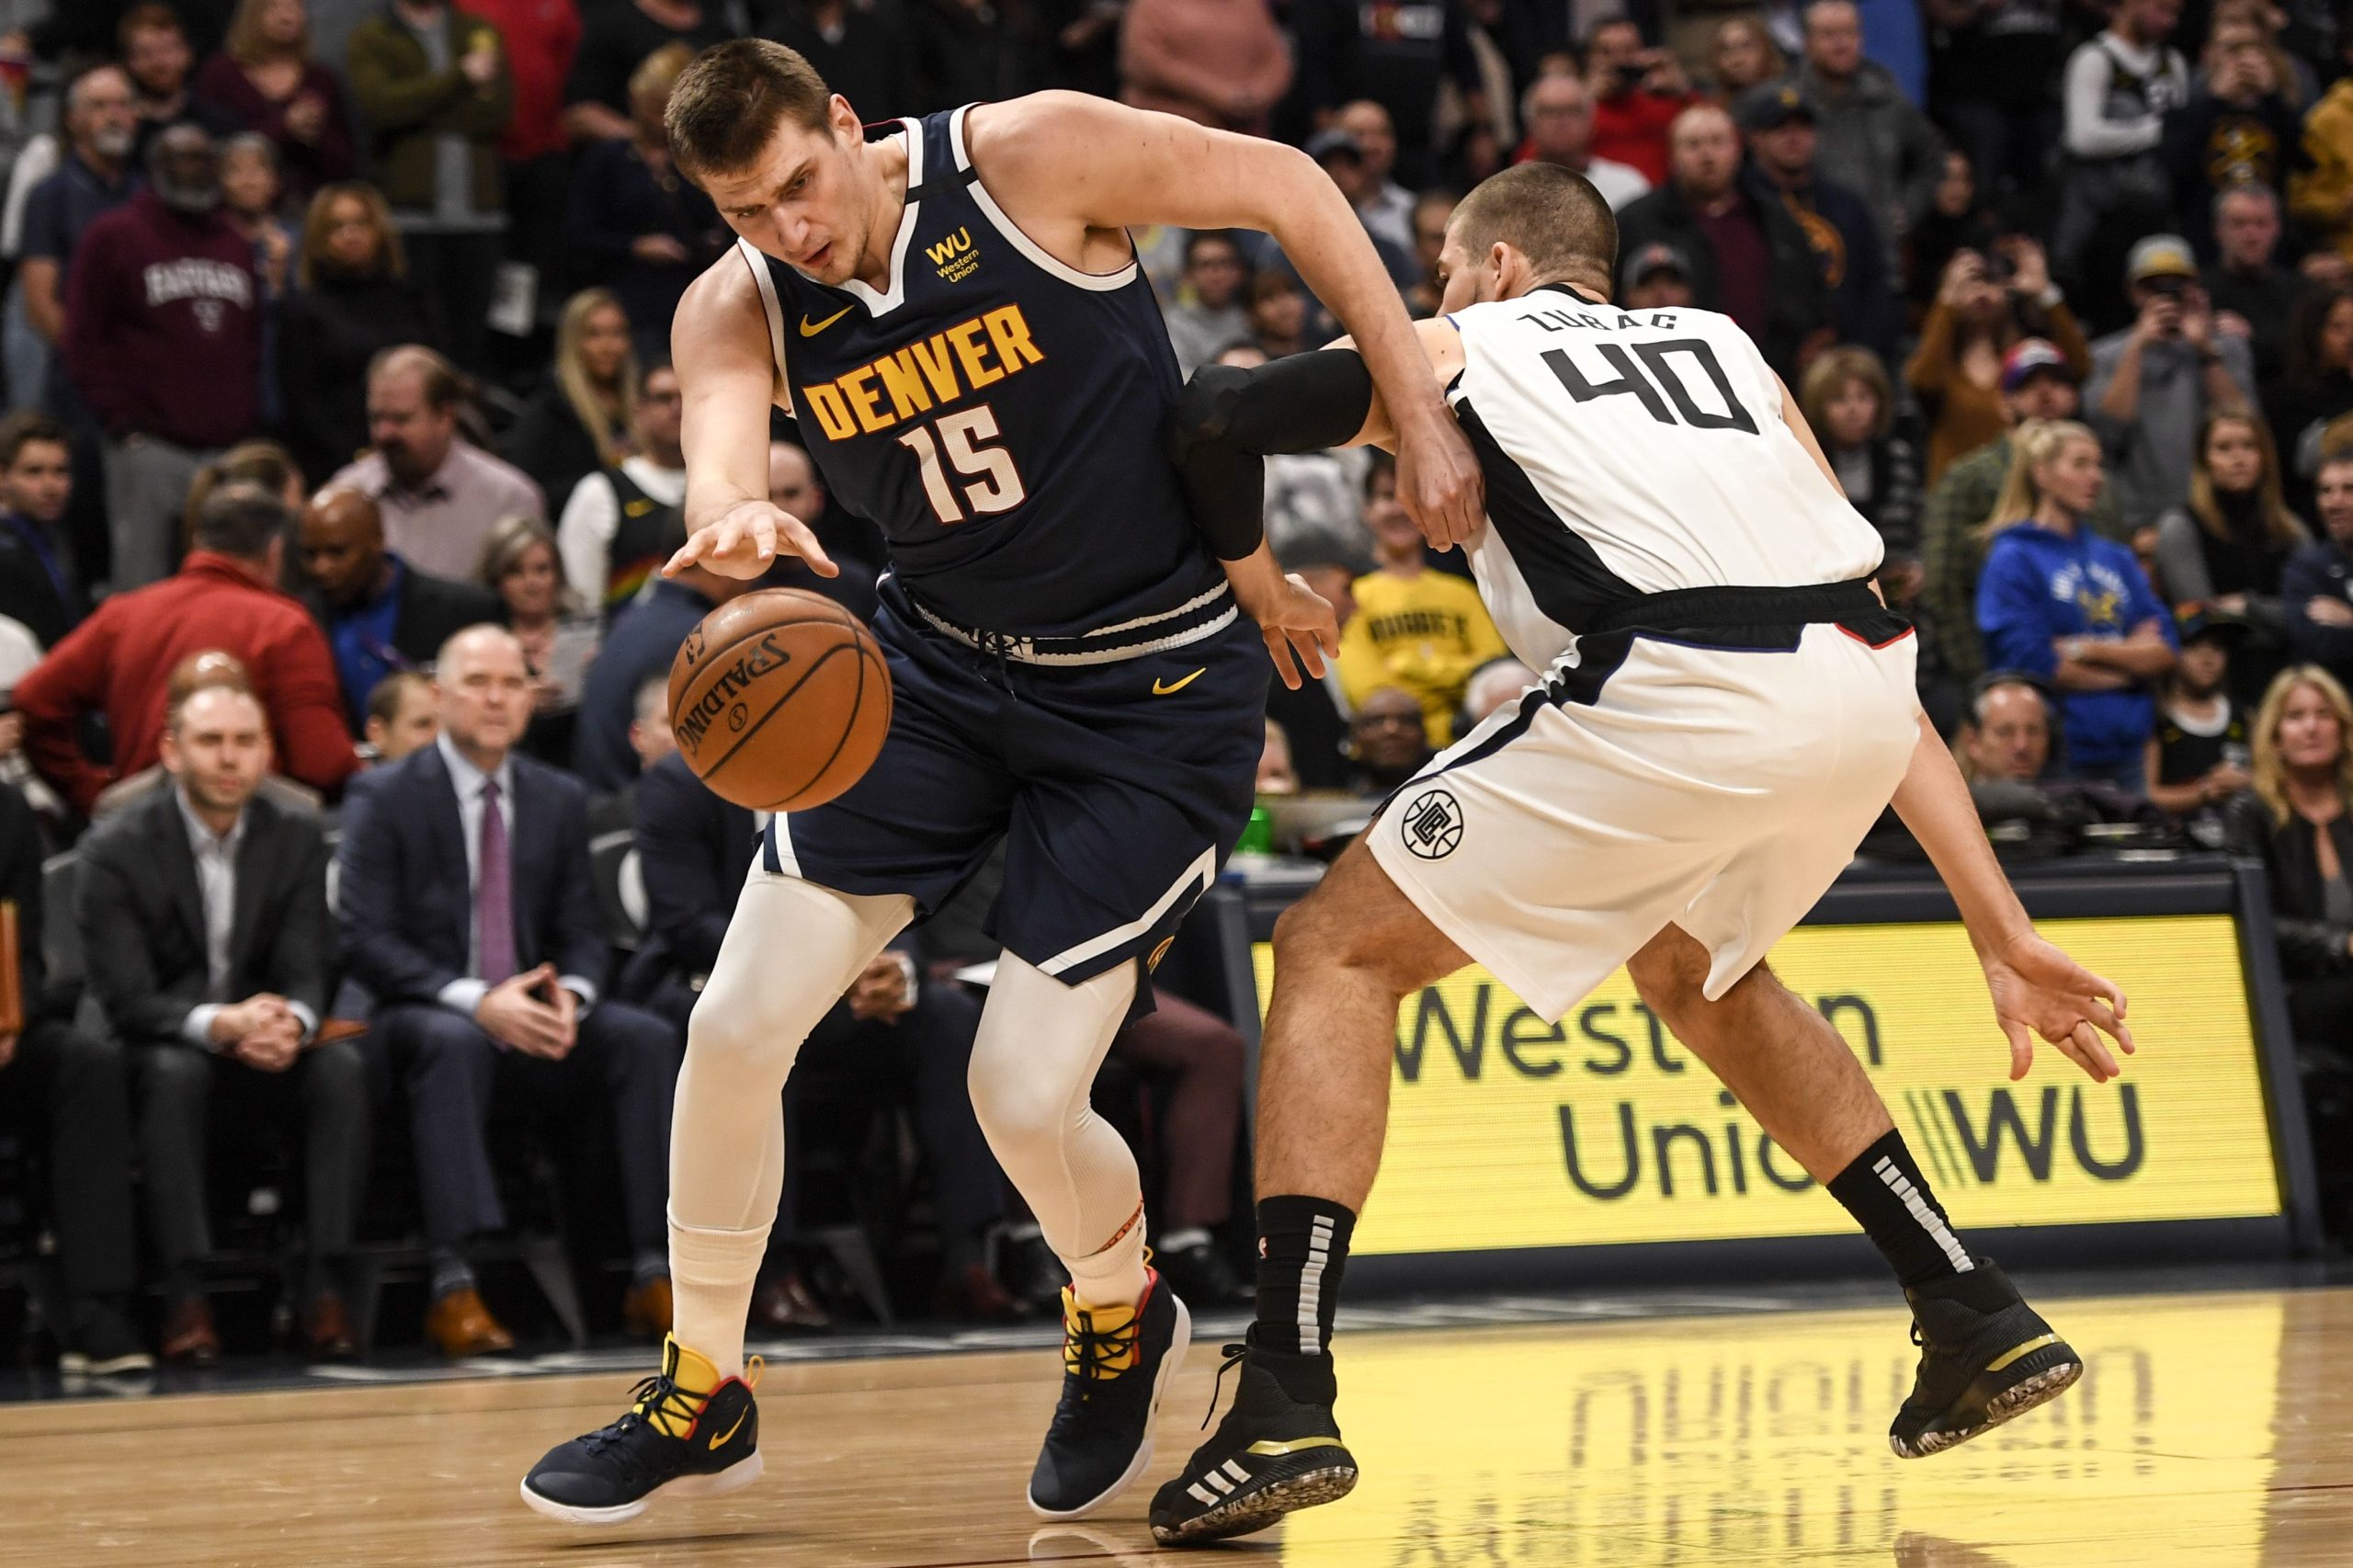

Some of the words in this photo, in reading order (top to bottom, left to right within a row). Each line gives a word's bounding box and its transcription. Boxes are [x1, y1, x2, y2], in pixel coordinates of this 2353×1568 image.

[925, 226, 972, 266] WU
[936, 249, 980, 278] Western
[948, 262, 979, 283] Union
[1516, 309, 1677, 332] ZUBAC
[801, 302, 1046, 441] DENVER
[1540, 338, 1760, 436] 40
[894, 402, 1028, 524] 15
[676, 632, 790, 758] SPALDING
[1394, 983, 1881, 1082] Westn
[1559, 1091, 1817, 1199] Unio
[1941, 1081, 2143, 1183] WU
